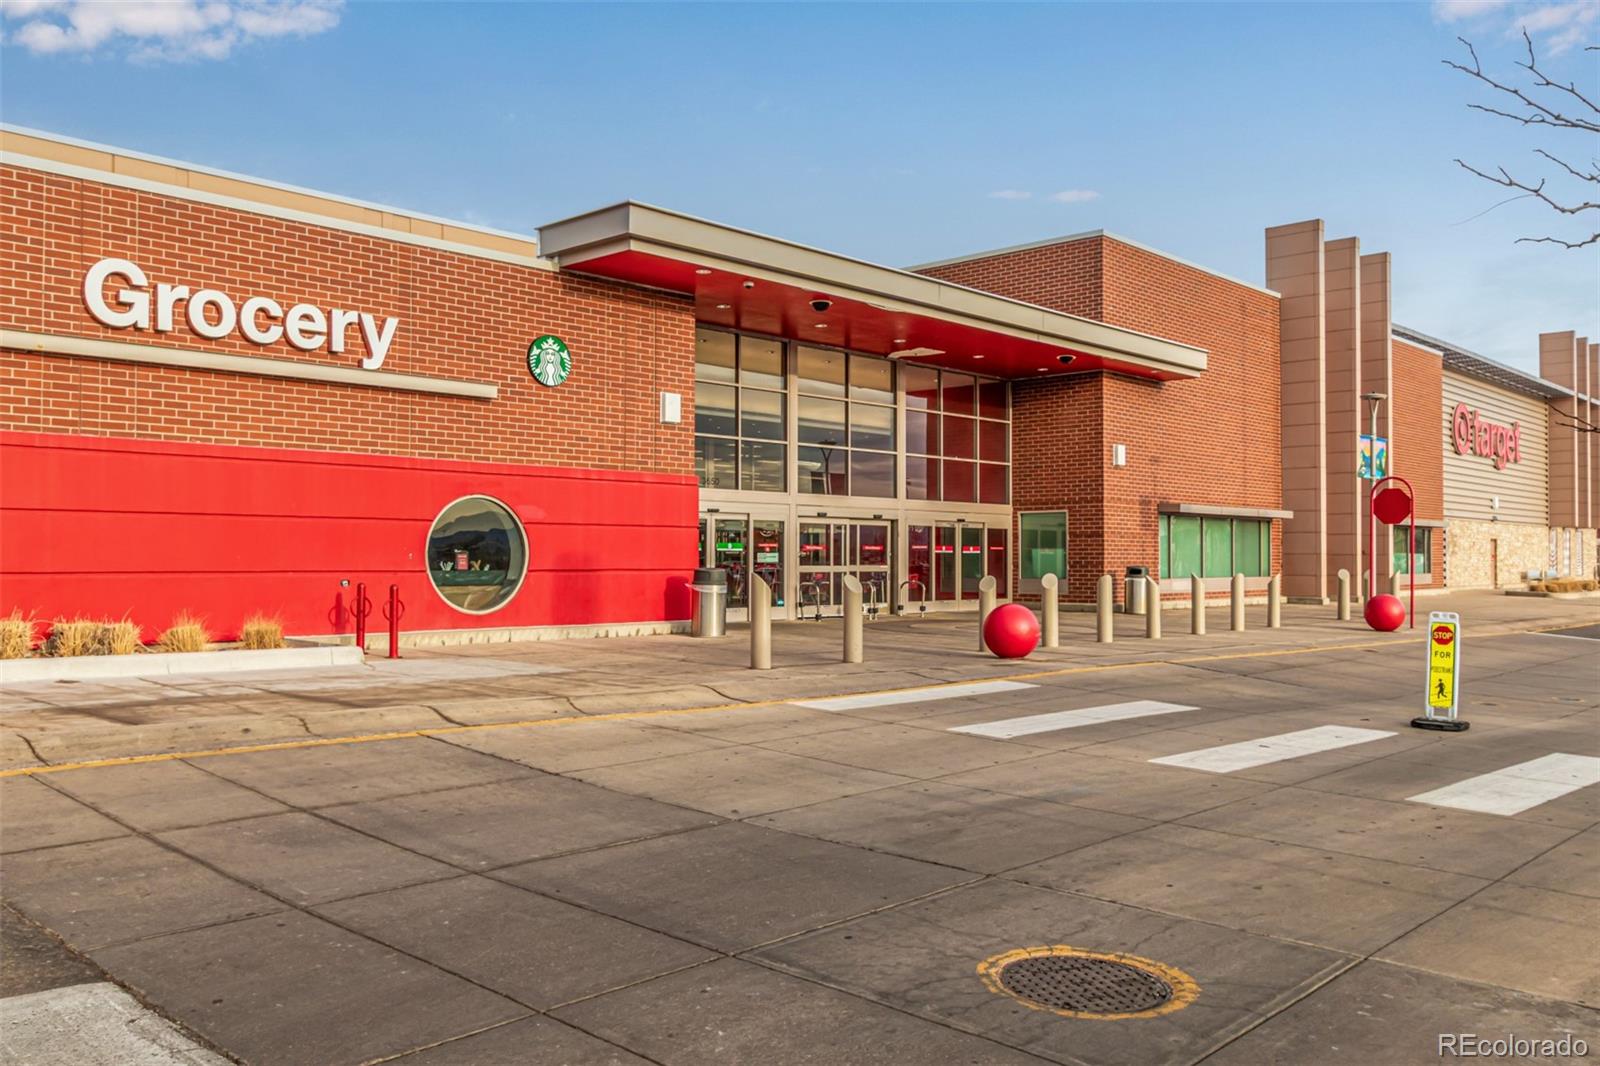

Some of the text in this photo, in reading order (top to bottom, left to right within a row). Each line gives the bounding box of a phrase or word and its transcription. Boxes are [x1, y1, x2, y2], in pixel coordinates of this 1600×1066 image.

[83, 257, 399, 370] Grocery
[1433, 631, 1453, 640] STOP
[1434, 651, 1451, 659] FOR
